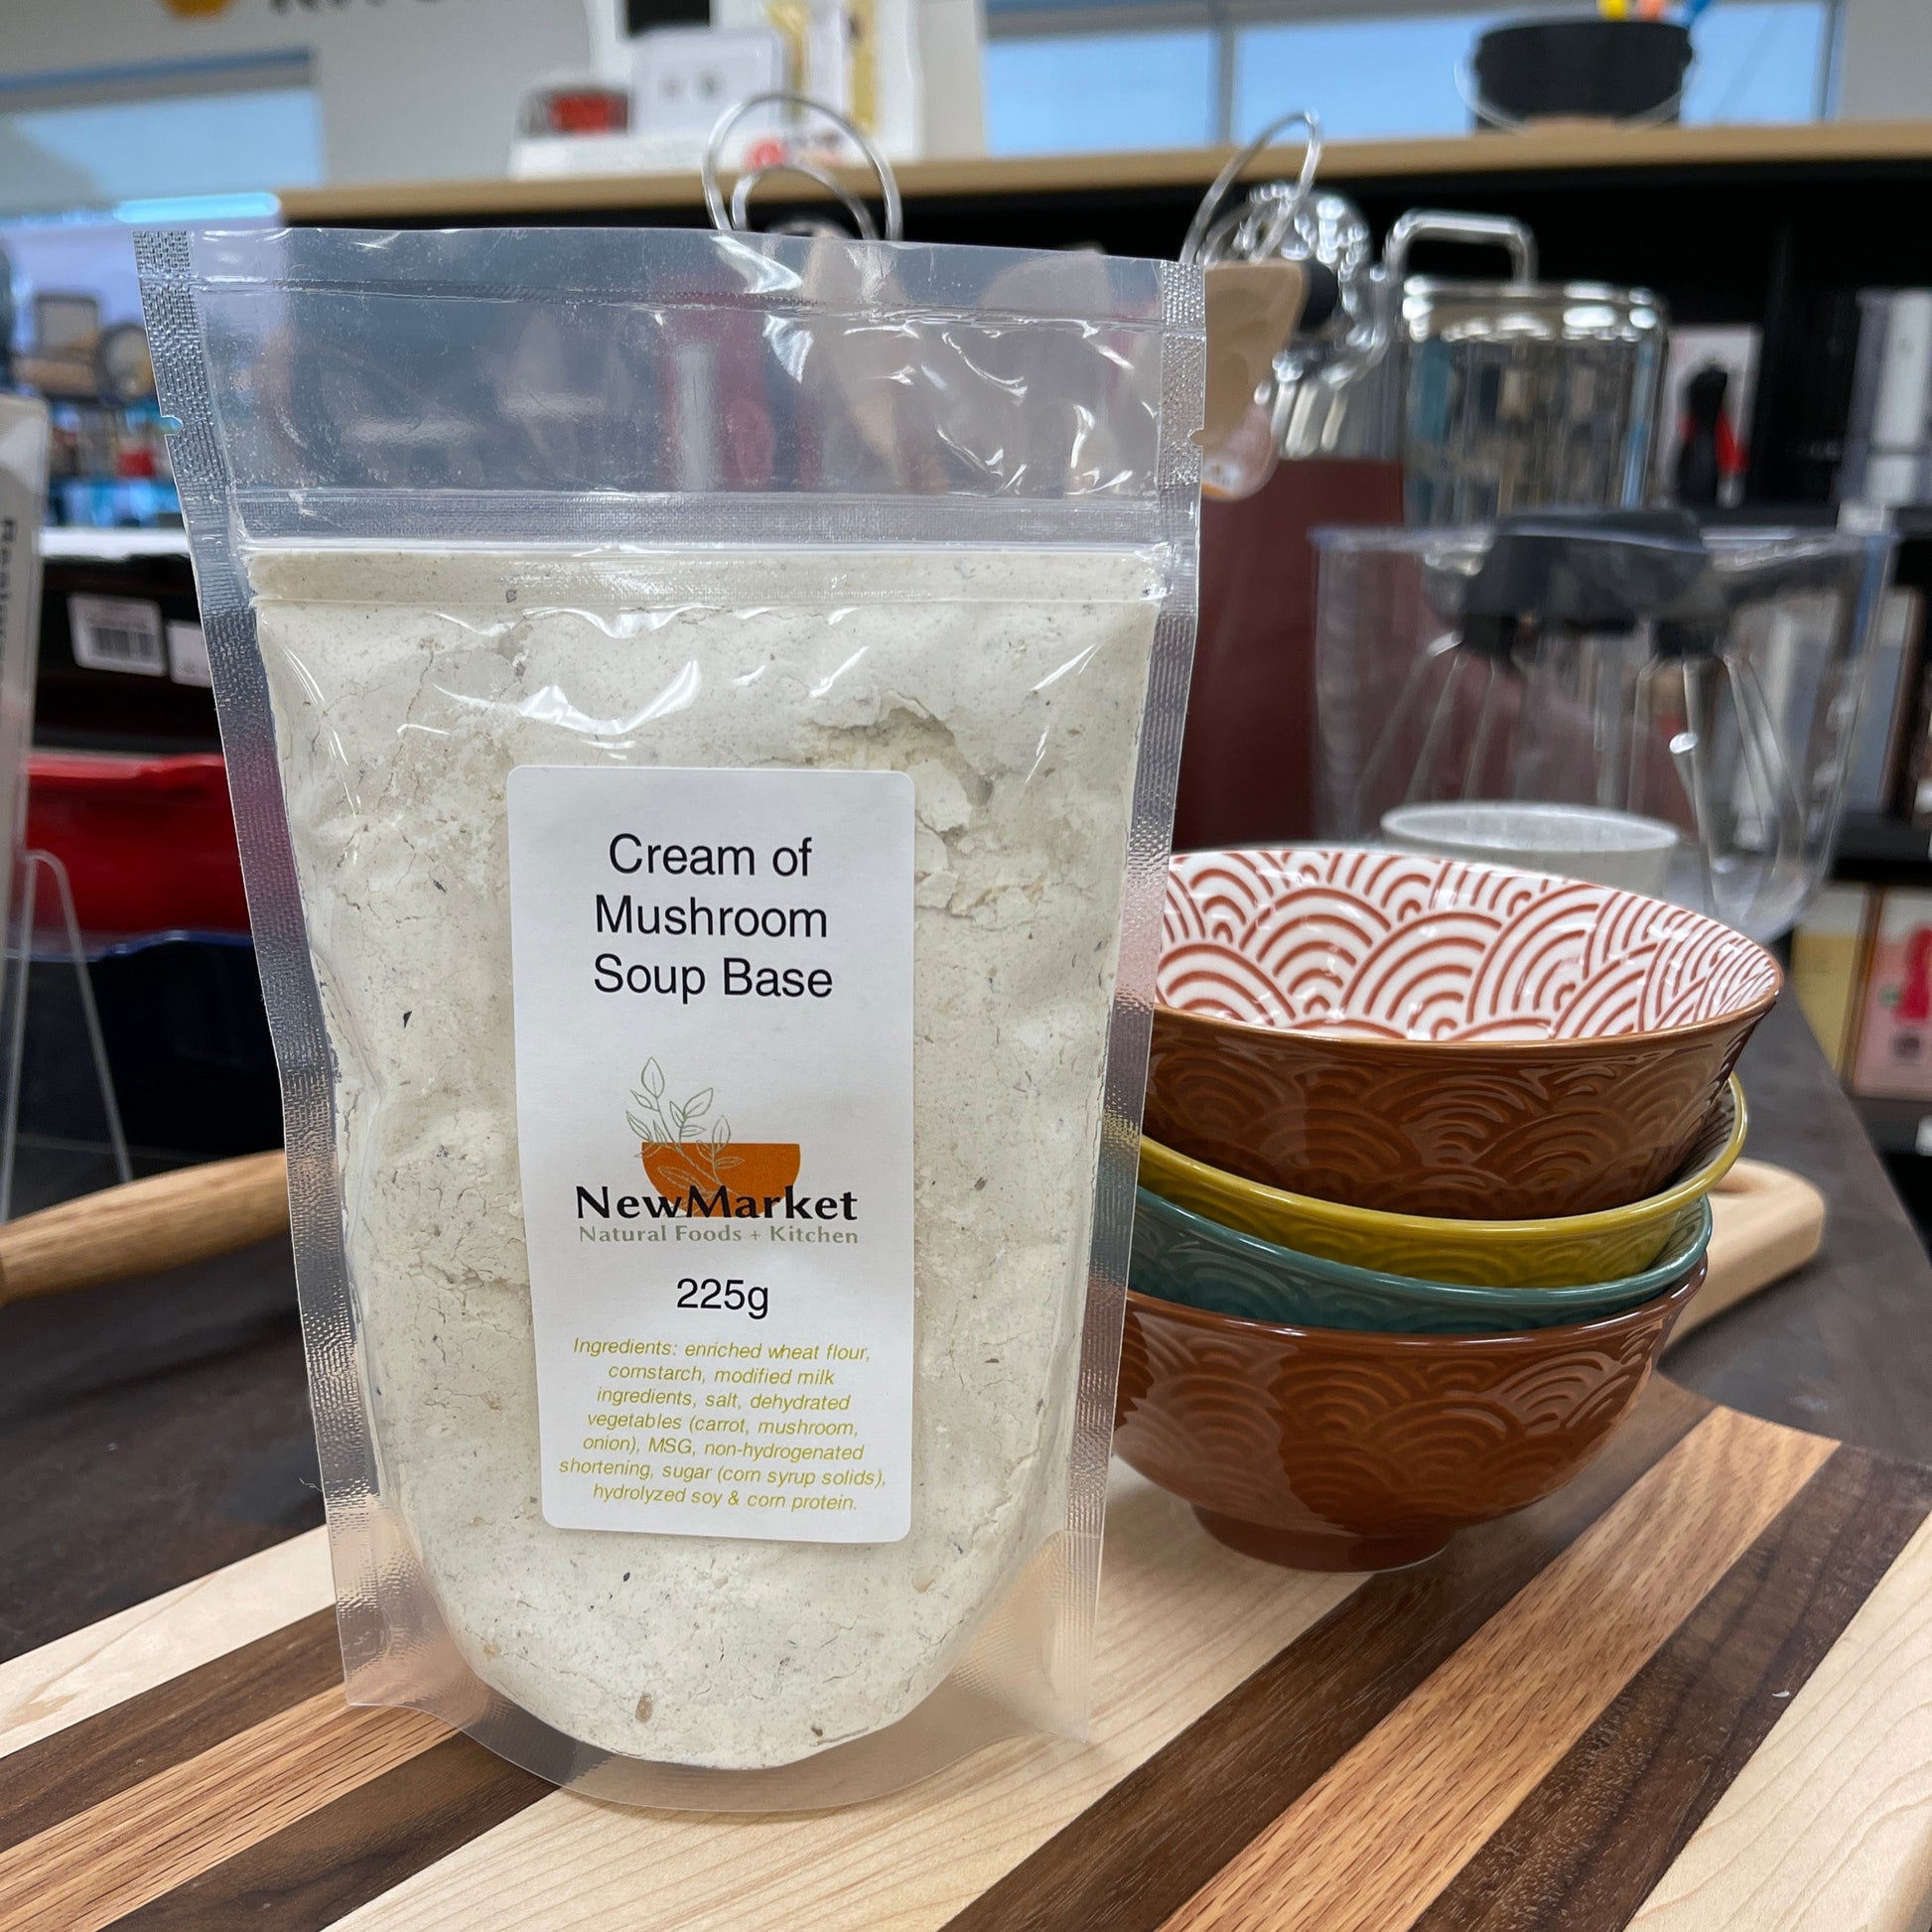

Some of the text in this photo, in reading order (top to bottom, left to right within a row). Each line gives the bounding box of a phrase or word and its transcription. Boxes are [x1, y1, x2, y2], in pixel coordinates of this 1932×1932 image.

[609, 833, 812, 877] Cream of
[596, 895, 827, 937] Mushroom
[594, 953, 833, 1005] Soup Base
[576, 1185, 858, 1221] NewMarket
[579, 1225, 858, 1244] Natural Foods + Kitchen
[677, 1278, 768, 1319] 225g
[573, 1337, 871, 1362] Ingredients: enriched wheat flour,
[608, 1365, 835, 1386] cornstarch, modified milk
[597, 1387, 852, 1414] ingredients, salt, dehydrated
[587, 1413, 859, 1438] vegetables (carrot, mushroom,
[583, 1436, 866, 1464] onion), MSG, non-hydrogenated
[559, 1457, 654, 1480] shortening,
[662, 1464, 712, 1483] sugar
[717, 1465, 761, 1484] (corn
[766, 1470, 817, 1488] syrup
[593, 1483, 858, 1513] hydrolyzed soy & corn protein.
